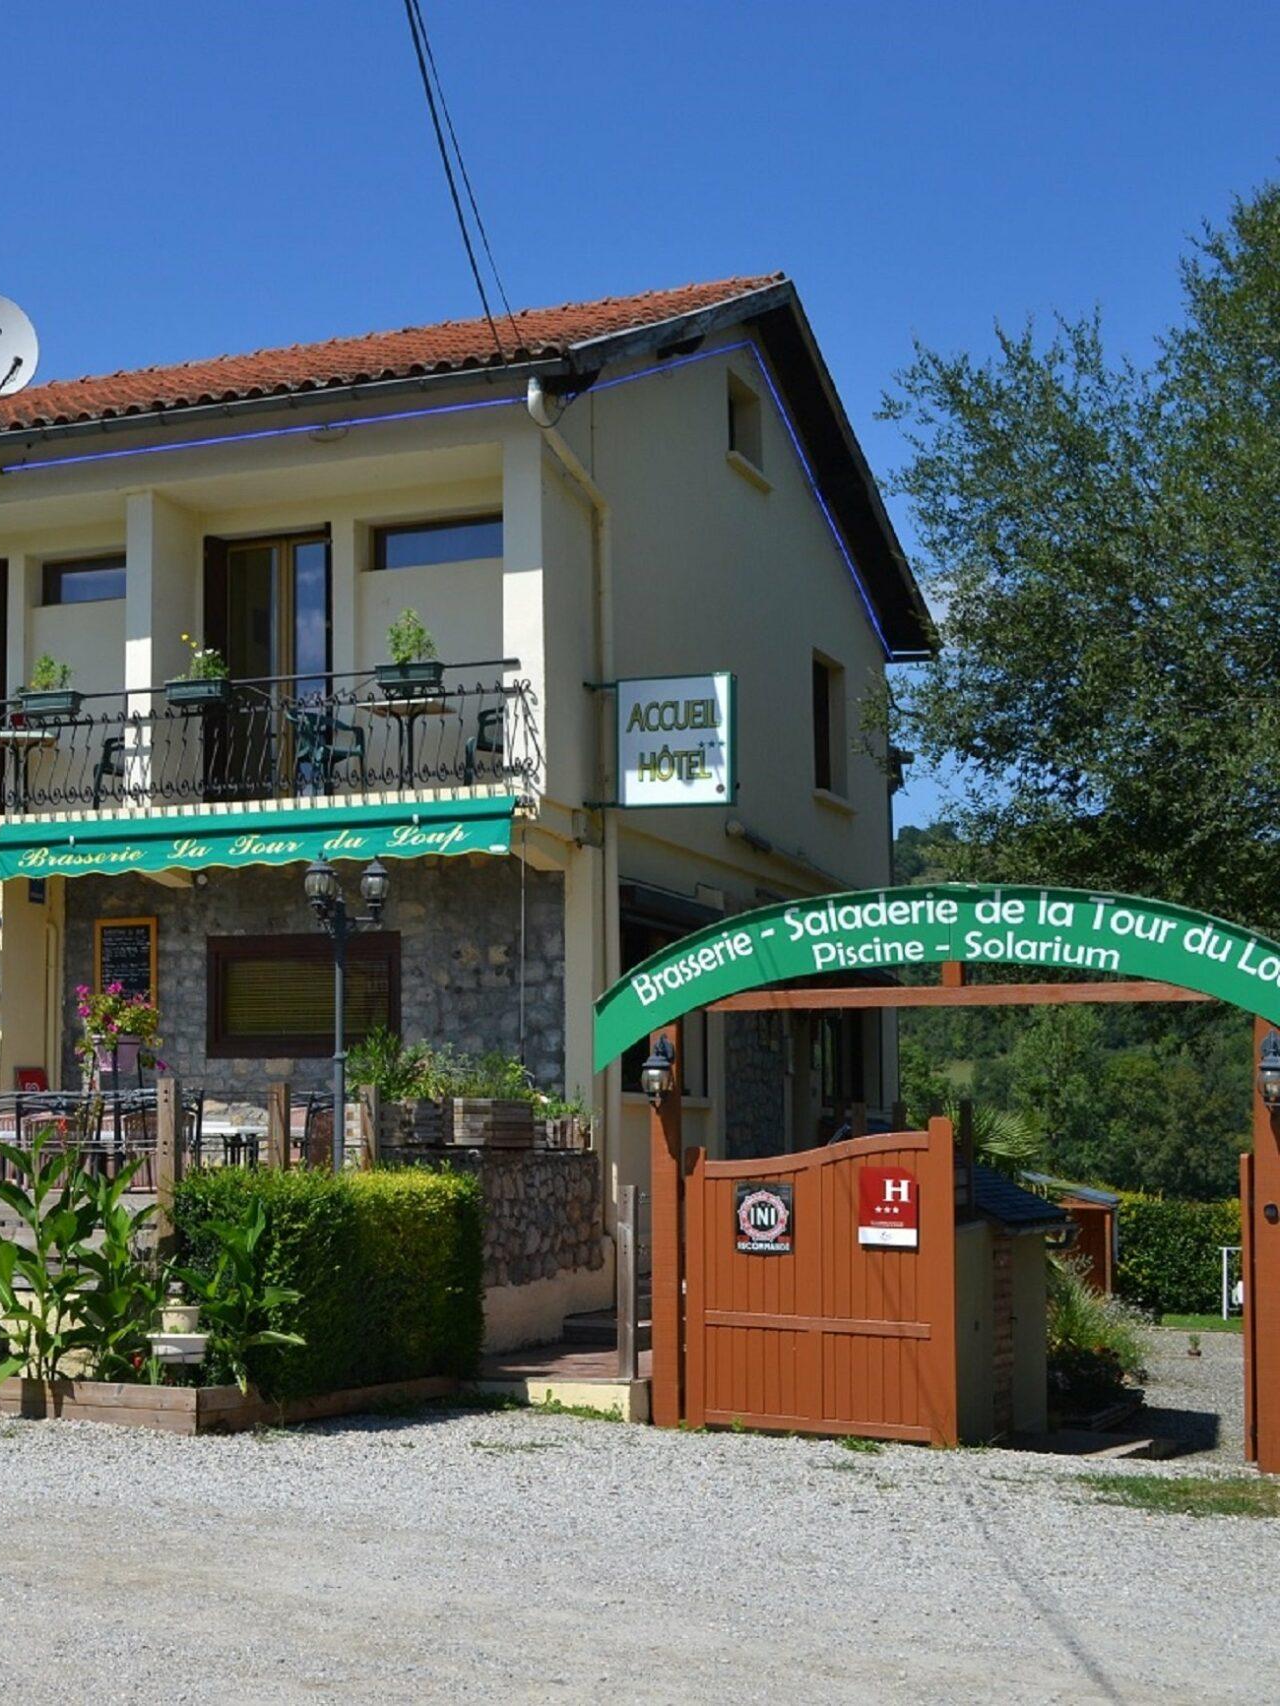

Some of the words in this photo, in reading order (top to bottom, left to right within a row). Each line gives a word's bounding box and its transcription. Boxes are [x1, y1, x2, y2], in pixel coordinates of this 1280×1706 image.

[626, 699, 721, 733] ACCUEIL
[637, 744, 712, 782] HÔTEL
[18, 846, 146, 867] Brasserie
[167, 838, 210, 858] La
[229, 834, 304, 854] Tour
[324, 830, 367, 849] du
[386, 823, 470, 850] Loup
[631, 930, 753, 1006] Brasserie
[784, 892, 958, 941] Saladerie
[974, 889, 1025, 924] de
[1037, 891, 1074, 927] la
[1088, 896, 1177, 943] Tour
[1183, 911, 1233, 962] du
[1236, 938, 1280, 988] Lo
[812, 937, 924, 970] Piscine
[964, 930, 1120, 970] Solarium
[882, 1179, 912, 1203] H
